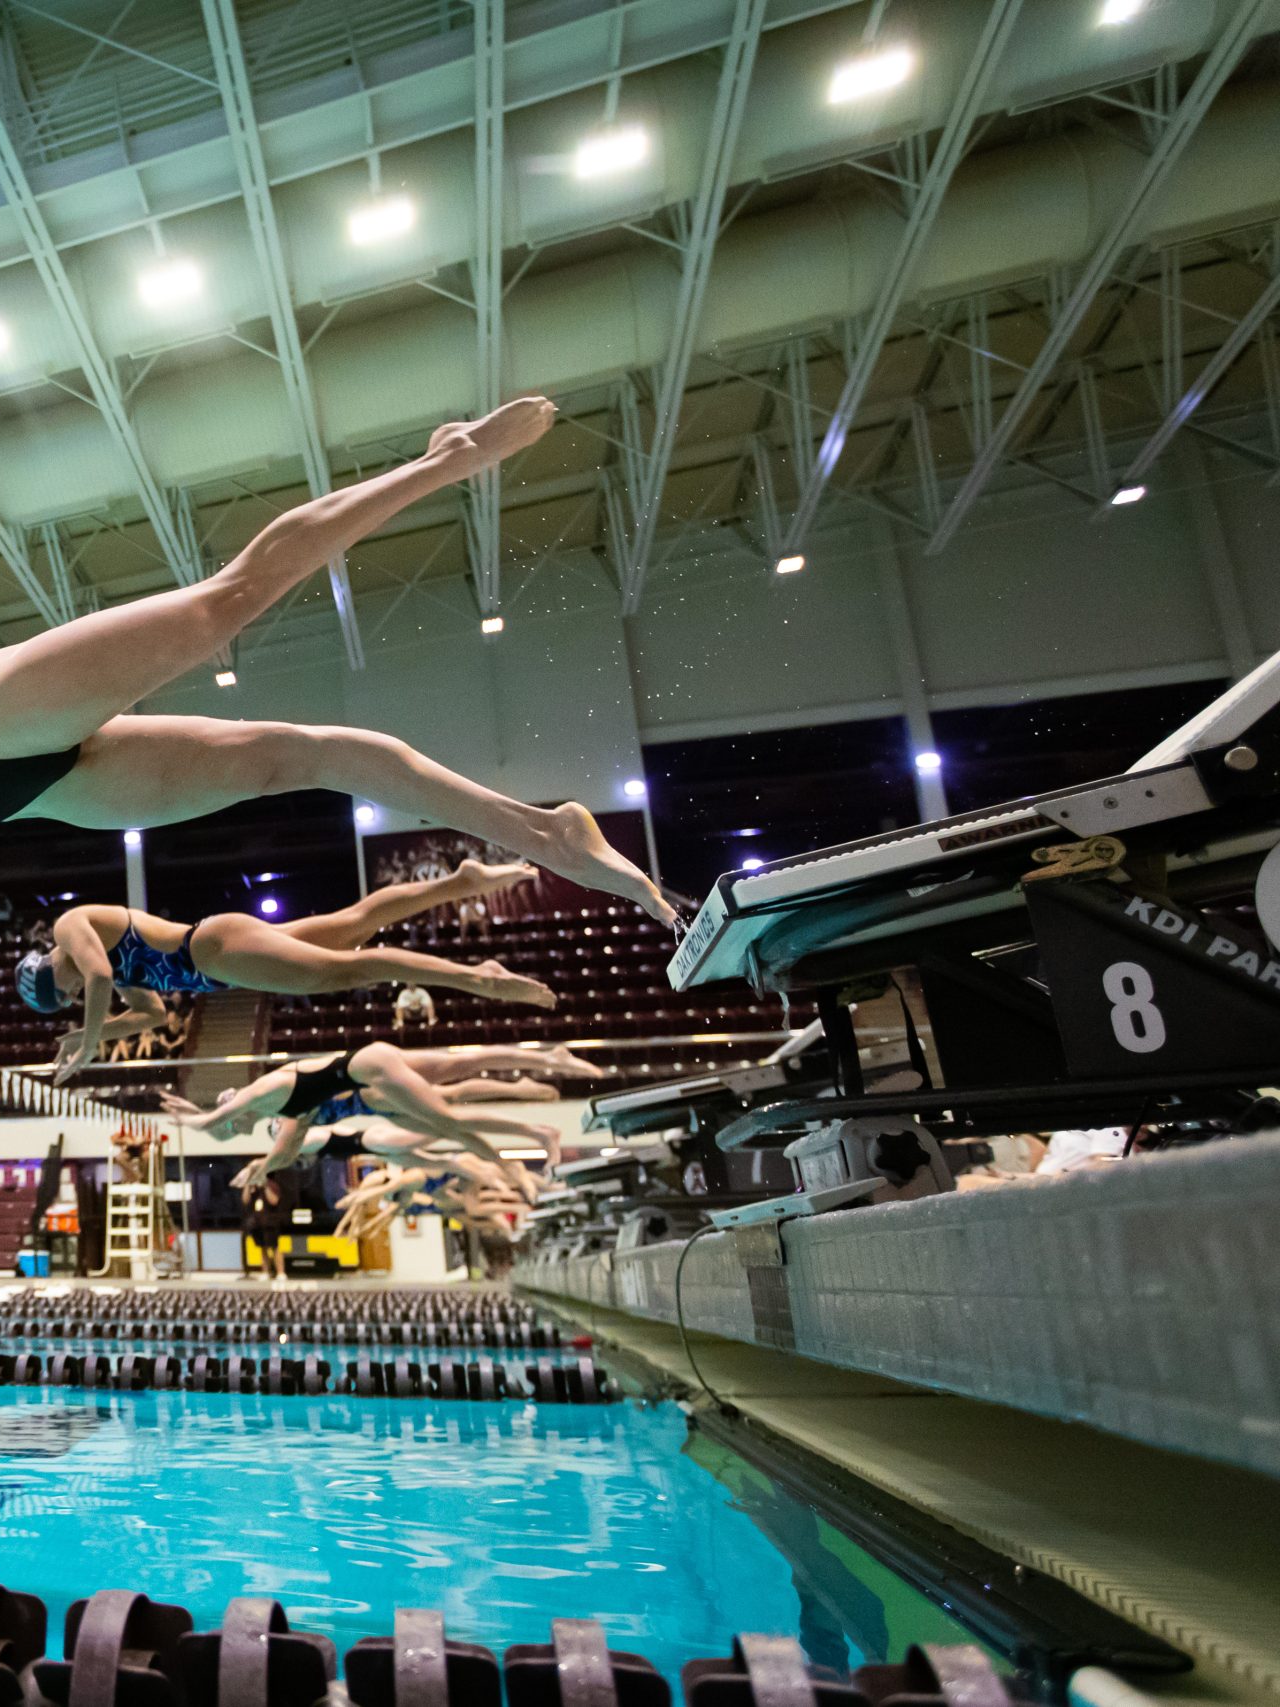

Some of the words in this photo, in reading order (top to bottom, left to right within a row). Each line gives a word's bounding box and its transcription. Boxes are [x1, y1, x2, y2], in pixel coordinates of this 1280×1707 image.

[676, 910, 715, 978] DAKTRONICS
[1124, 896, 1200, 944] KDI
[1102, 961, 1166, 1053] 8
